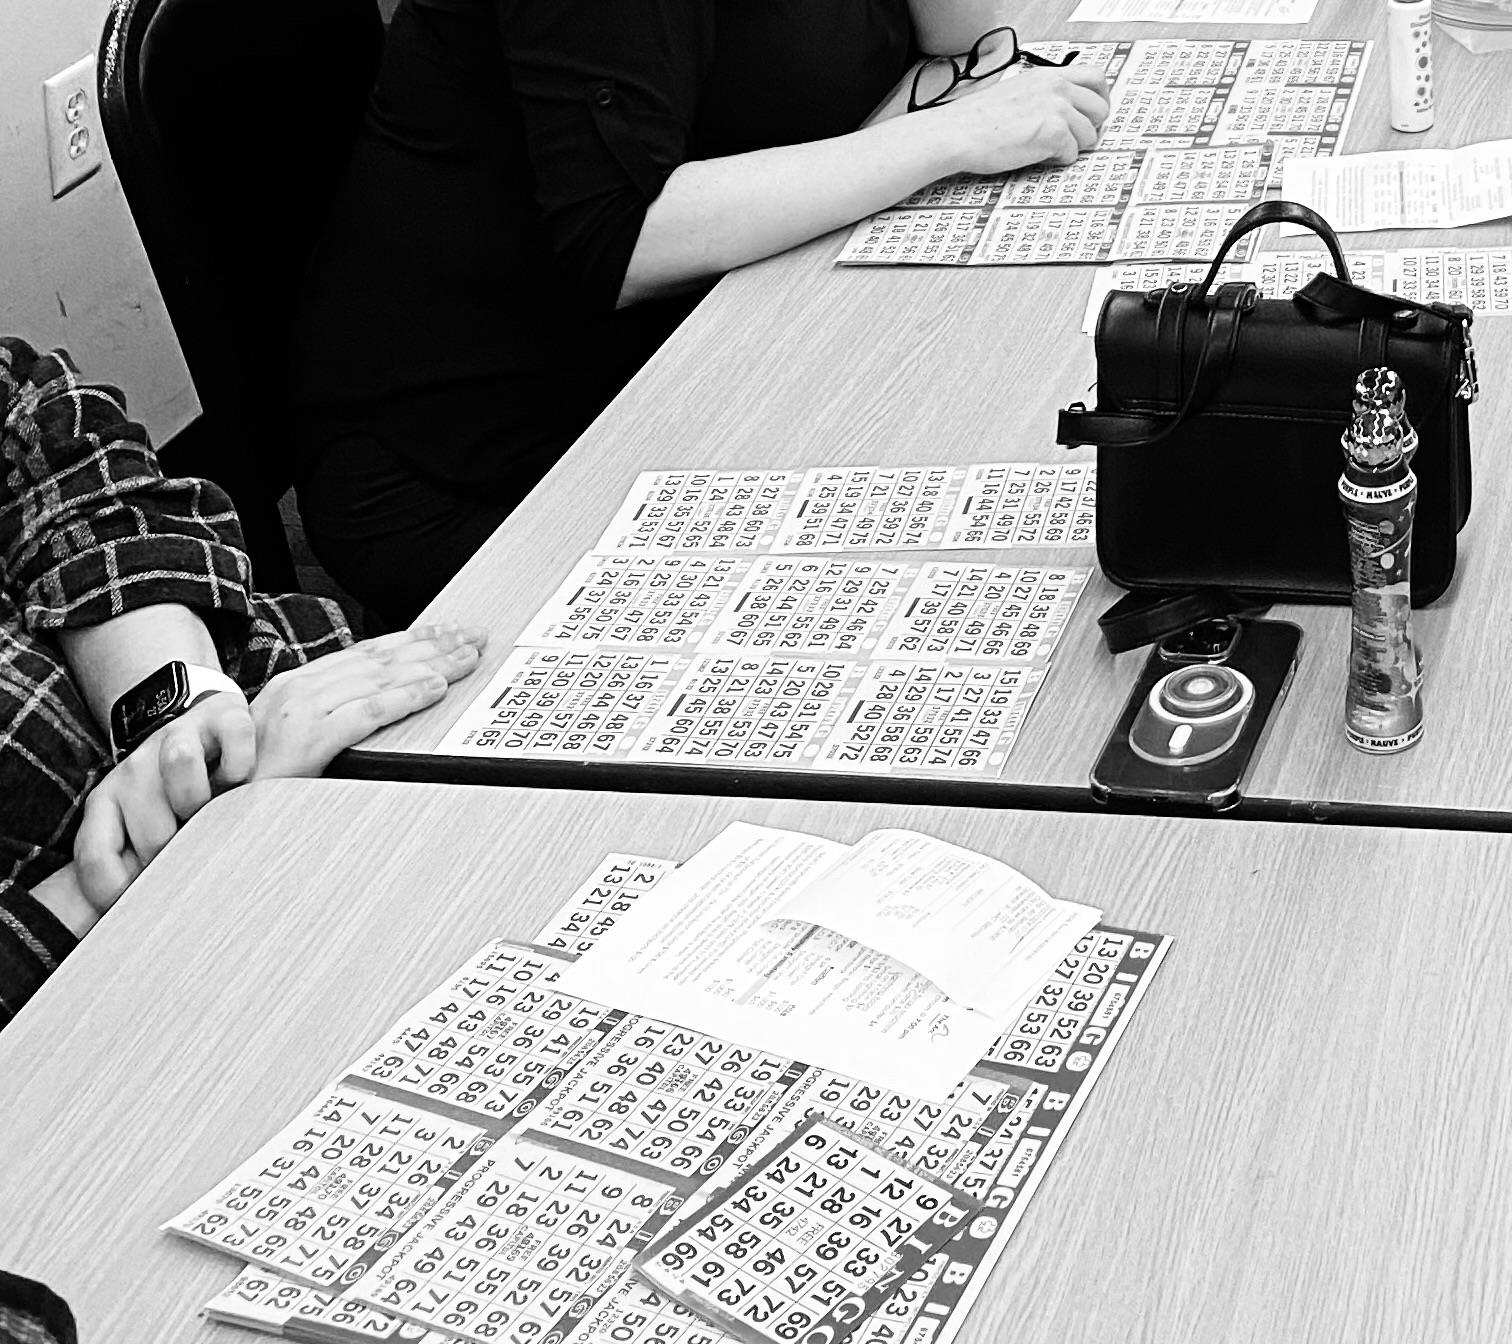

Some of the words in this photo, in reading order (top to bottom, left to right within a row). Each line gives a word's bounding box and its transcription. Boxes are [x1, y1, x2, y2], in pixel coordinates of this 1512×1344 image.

[543, 655, 559, 663] 9
[566, 654, 589, 668] 11
[525, 670, 548, 686] 18
[552, 671, 575, 686] 30
[507, 691, 531, 705] 42
[537, 691, 561, 706] 39
[491, 711, 517, 724] 51
[521, 712, 545, 728] 49
[477, 731, 500, 747] 65
[505, 732, 530, 747] 70
[549, 1070, 590, 1122] JACKPOT
[738, 1123, 773, 1170] JACKPOT
[804, 1134, 826, 1150] 6
[827, 1147, 858, 1169] 13
[767, 1157, 801, 1185] 24
[861, 1168, 880, 1178] 1
[795, 1172, 827, 1197] 21
[880, 1178, 913, 1200] 12
[732, 1186, 767, 1213] 34
[821, 1187, 855, 1213] 28
[916, 1195, 938, 1209] 9
[697, 1215, 733, 1241] 54
[760, 1202, 794, 1229] 35
[850, 1206, 881, 1228] 16
[881, 1217, 912, 1247] 27
[662, 1243, 697, 1269] 66
[725, 1232, 761, 1258] 58
[817, 1232, 851, 1260] 39
[753, 1248, 785, 1275] 46
[844, 1248, 879, 1276] 33
[692, 1262, 724, 1287] 61
[785, 1264, 817, 1294] 57
[718, 1279, 756, 1305] 73
[812, 1281, 846, 1306] 51
[744, 1296, 785, 1322] 72
[775, 1312, 810, 1339] 69
